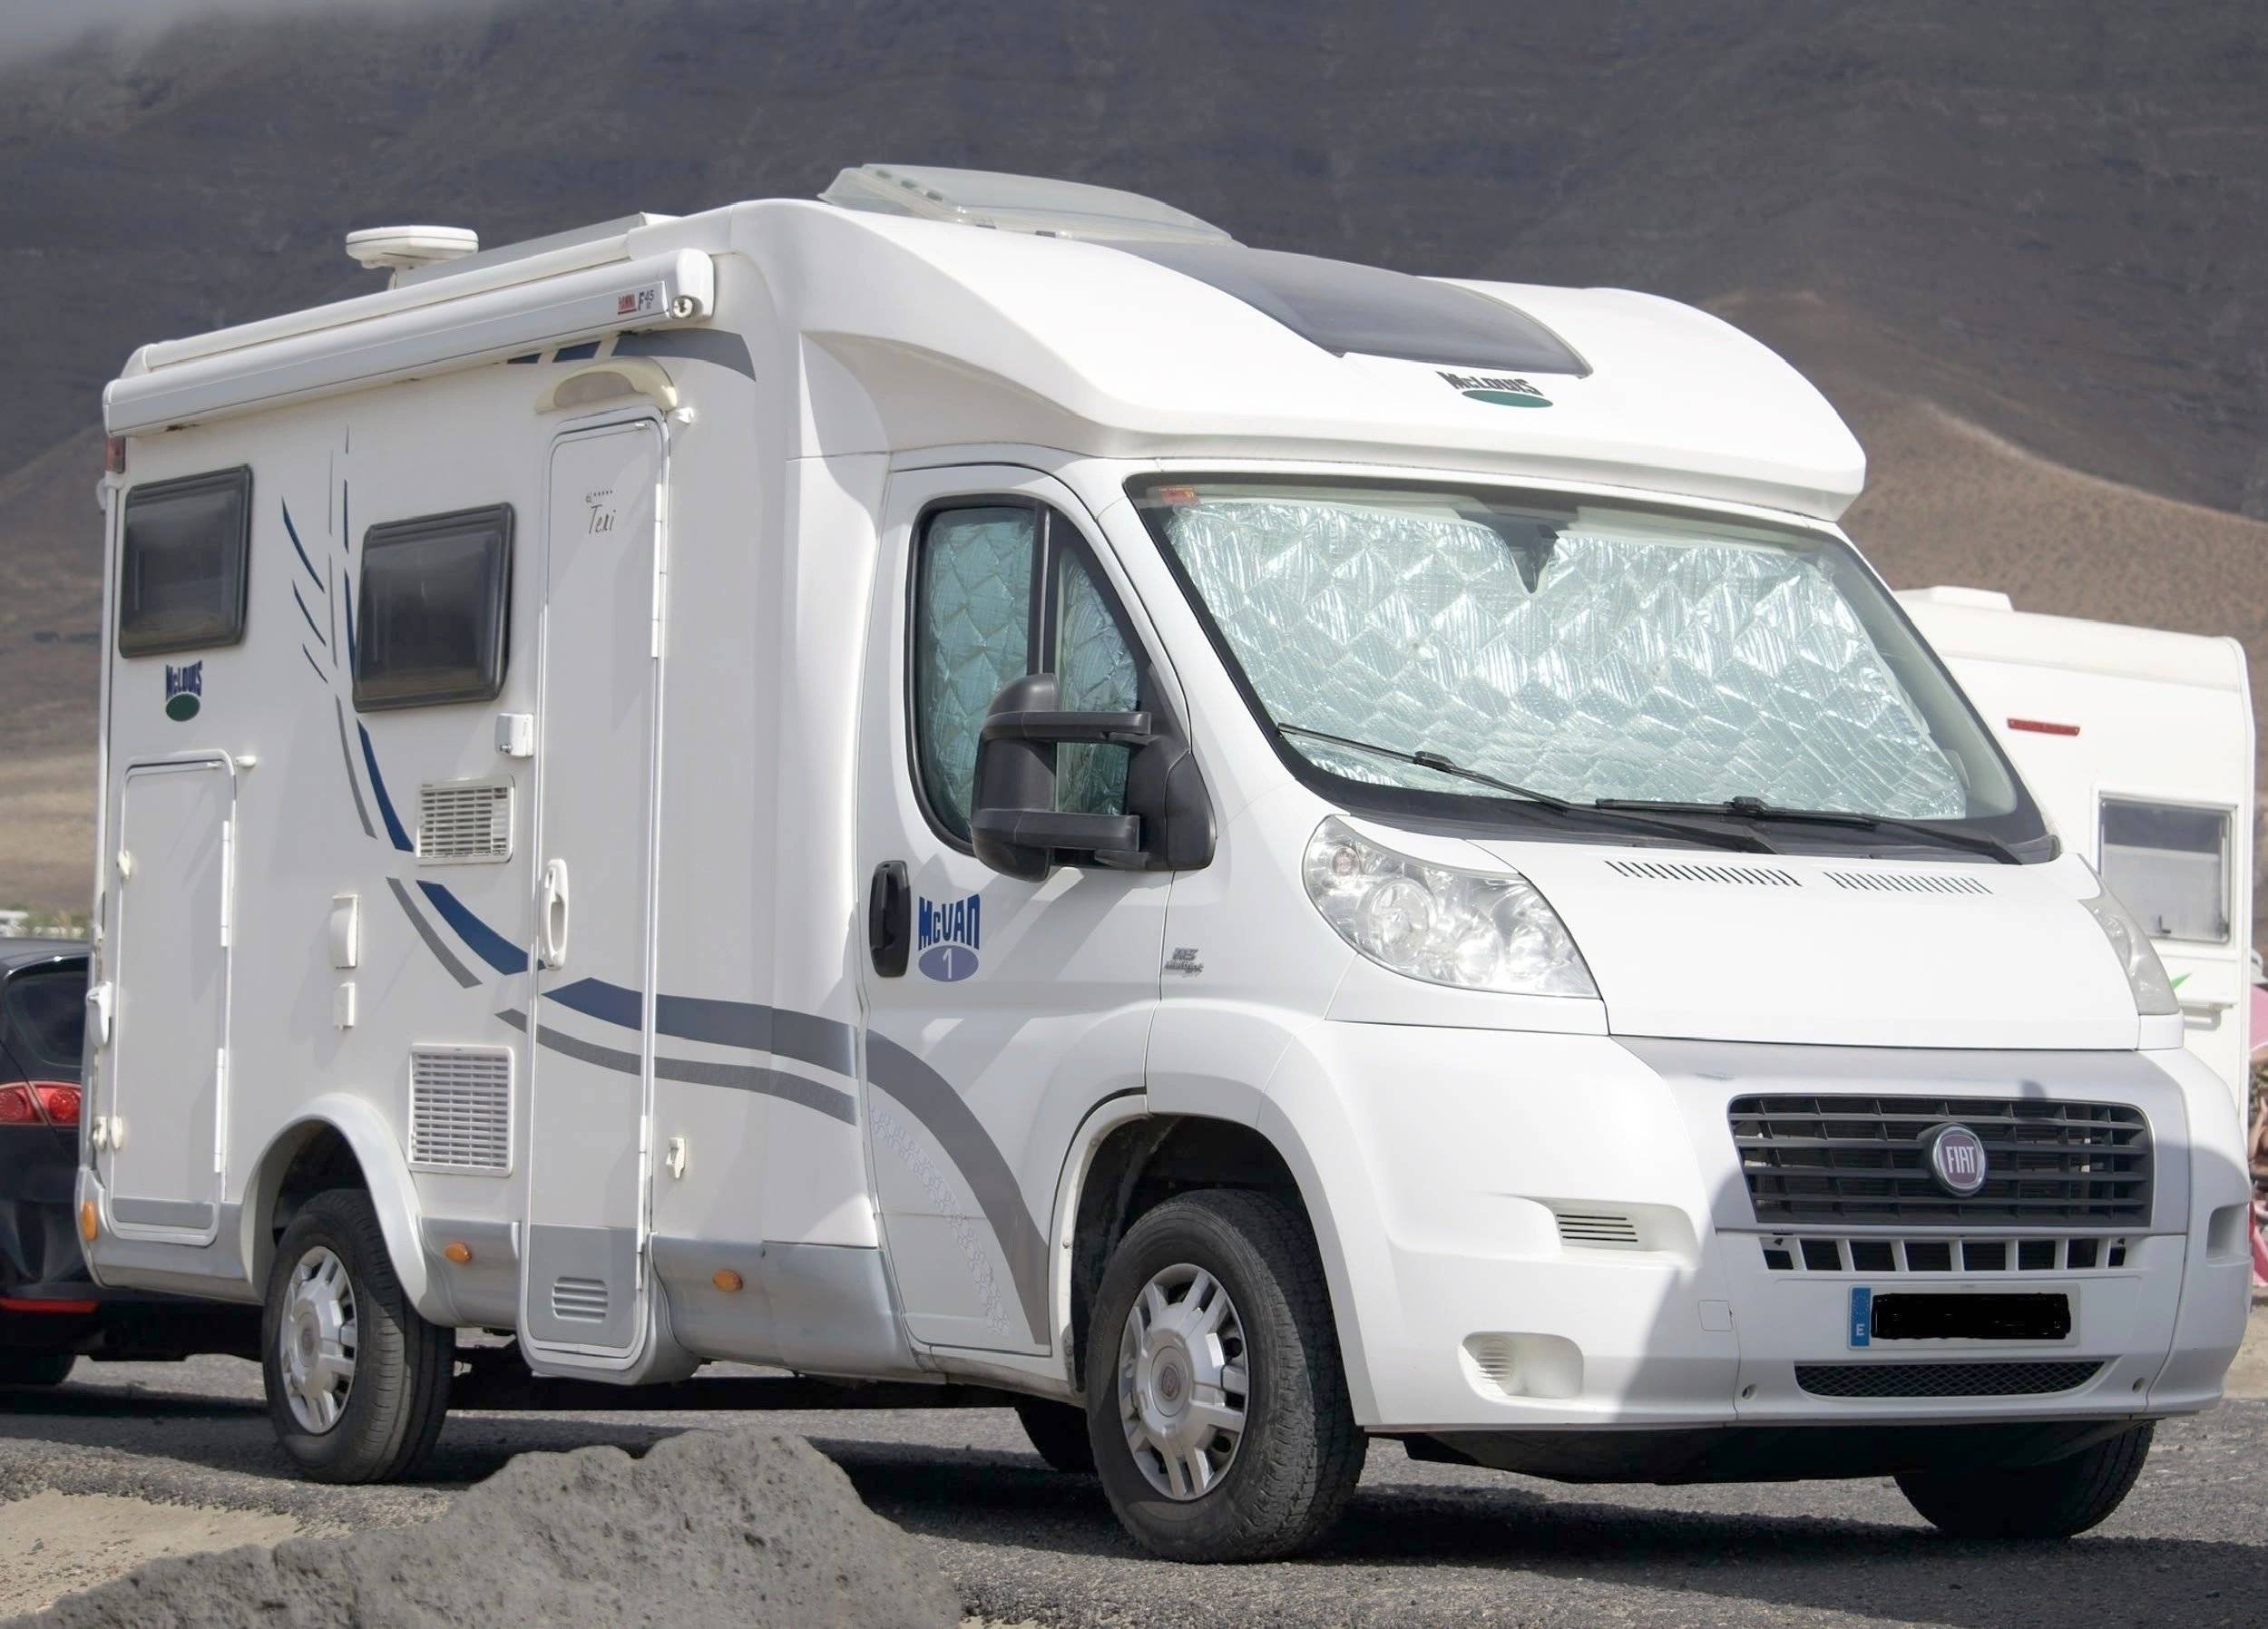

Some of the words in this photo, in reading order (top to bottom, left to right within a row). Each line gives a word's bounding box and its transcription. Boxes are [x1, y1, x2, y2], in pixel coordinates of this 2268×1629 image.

[943, 947, 953, 980] 1
[1945, 1146, 1976, 1174] FIAT
[1855, 1323, 1865, 1336] E
